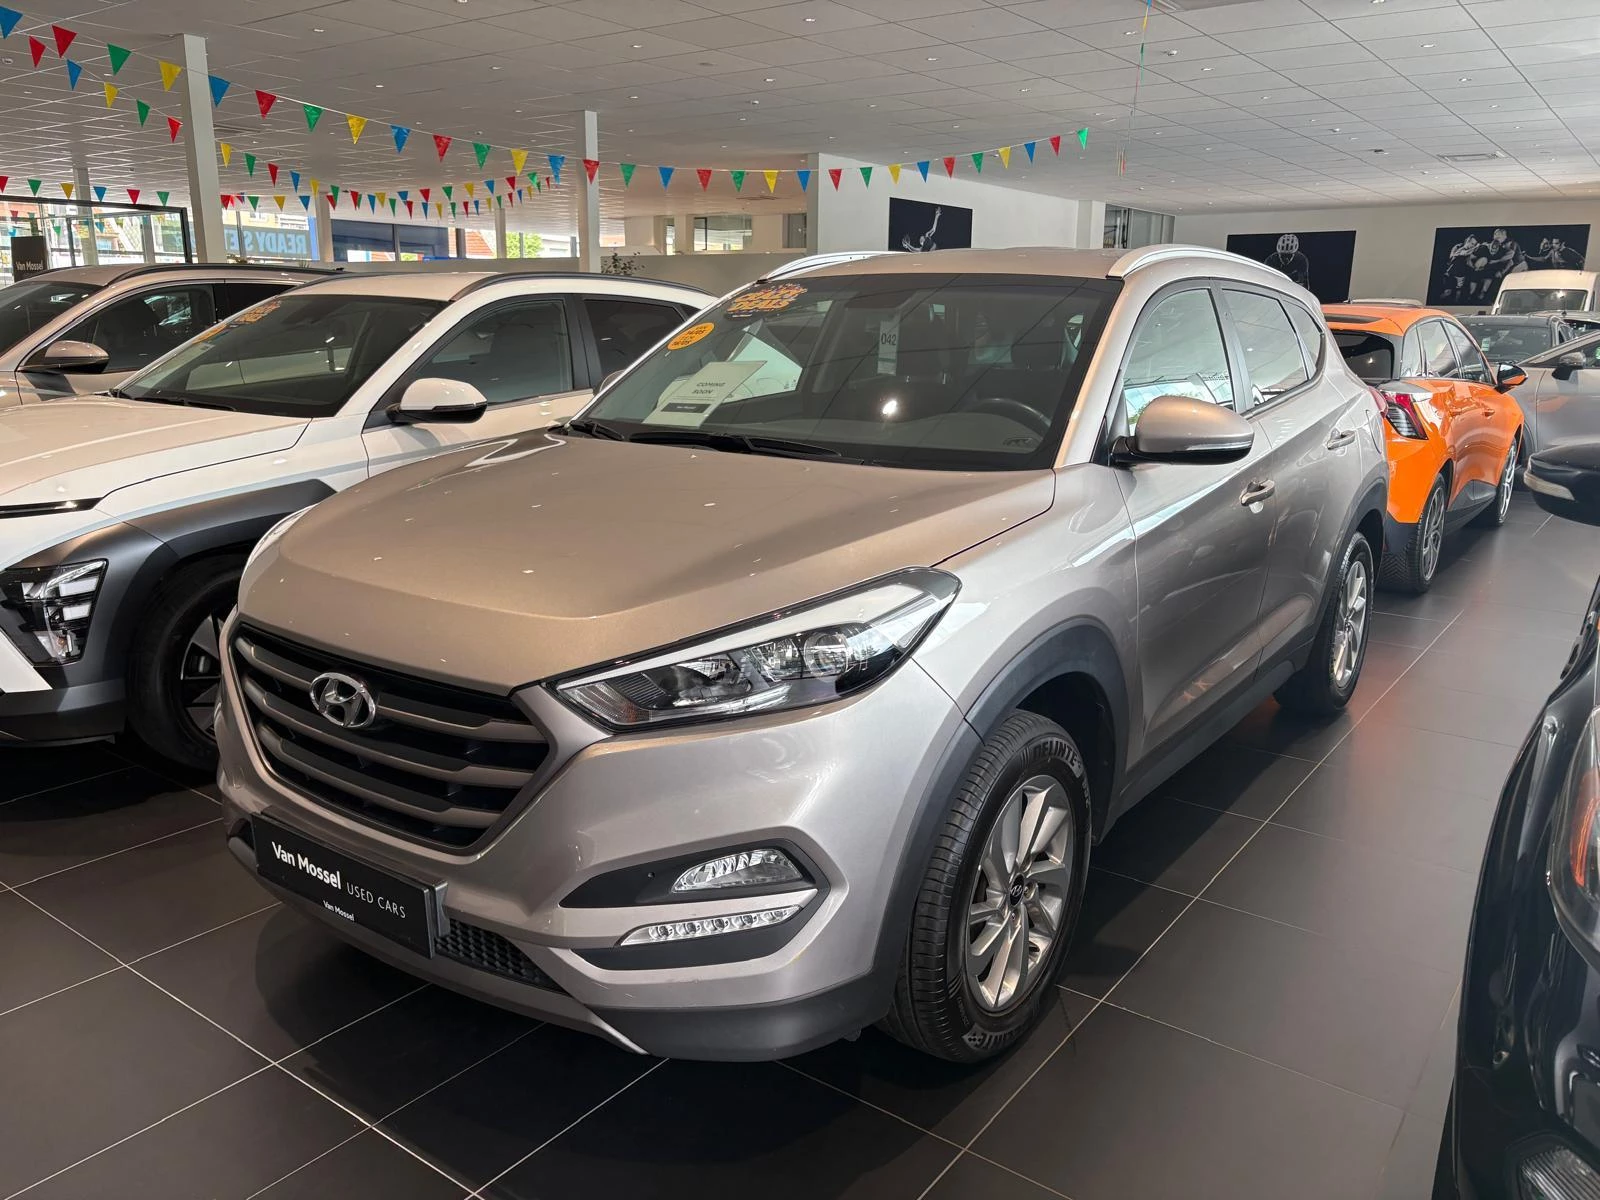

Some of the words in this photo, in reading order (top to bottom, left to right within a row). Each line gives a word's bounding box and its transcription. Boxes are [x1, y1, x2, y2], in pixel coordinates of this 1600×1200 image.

[15, 260, 26, 271] Van
[26, 259, 44, 271] Mossel
[881, 332, 897, 346] 042
[271, 841, 296, 867] Van
[297, 853, 342, 889] Mossel
[346, 882, 374, 904] USED
[377, 896, 406, 919] CARS
[323, 900, 334, 911] Van
[334, 905, 355, 921] Mossel
